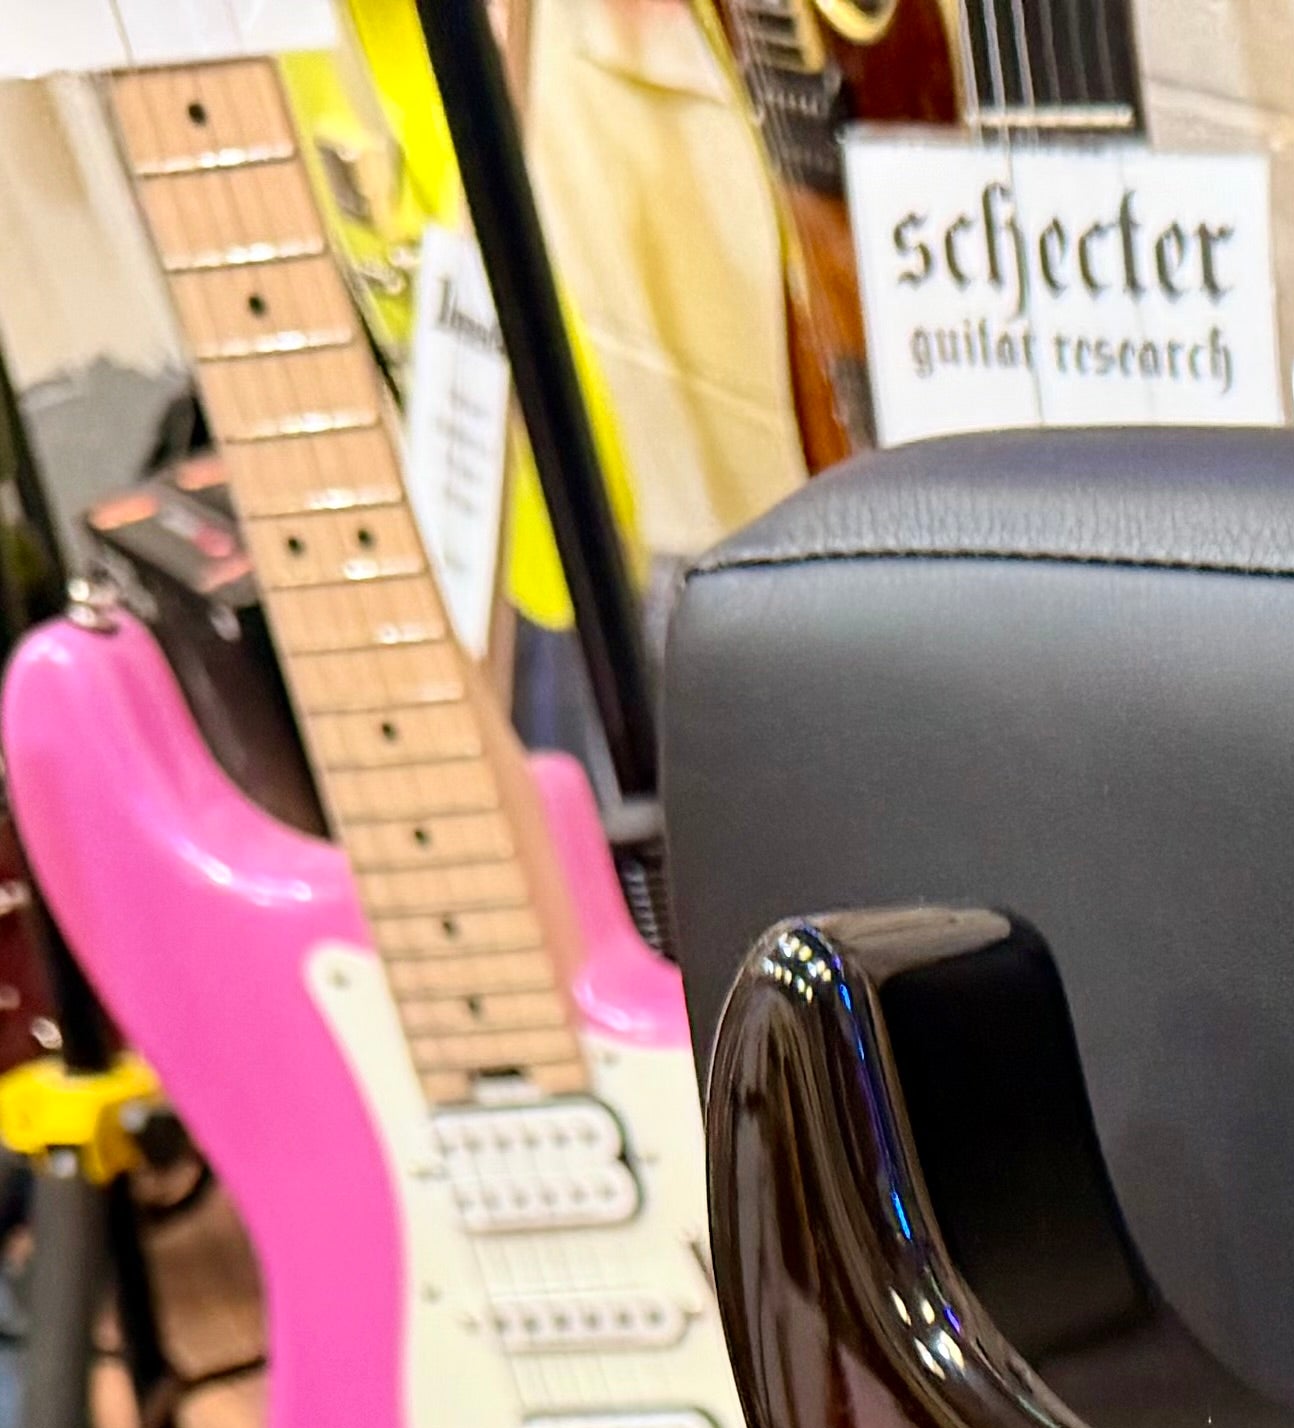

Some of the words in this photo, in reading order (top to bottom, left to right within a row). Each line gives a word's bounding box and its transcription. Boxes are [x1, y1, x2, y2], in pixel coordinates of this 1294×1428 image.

[893, 181, 1235, 316] schecter
[909, 318, 1036, 378] guitar
[1051, 325, 1232, 393] research
